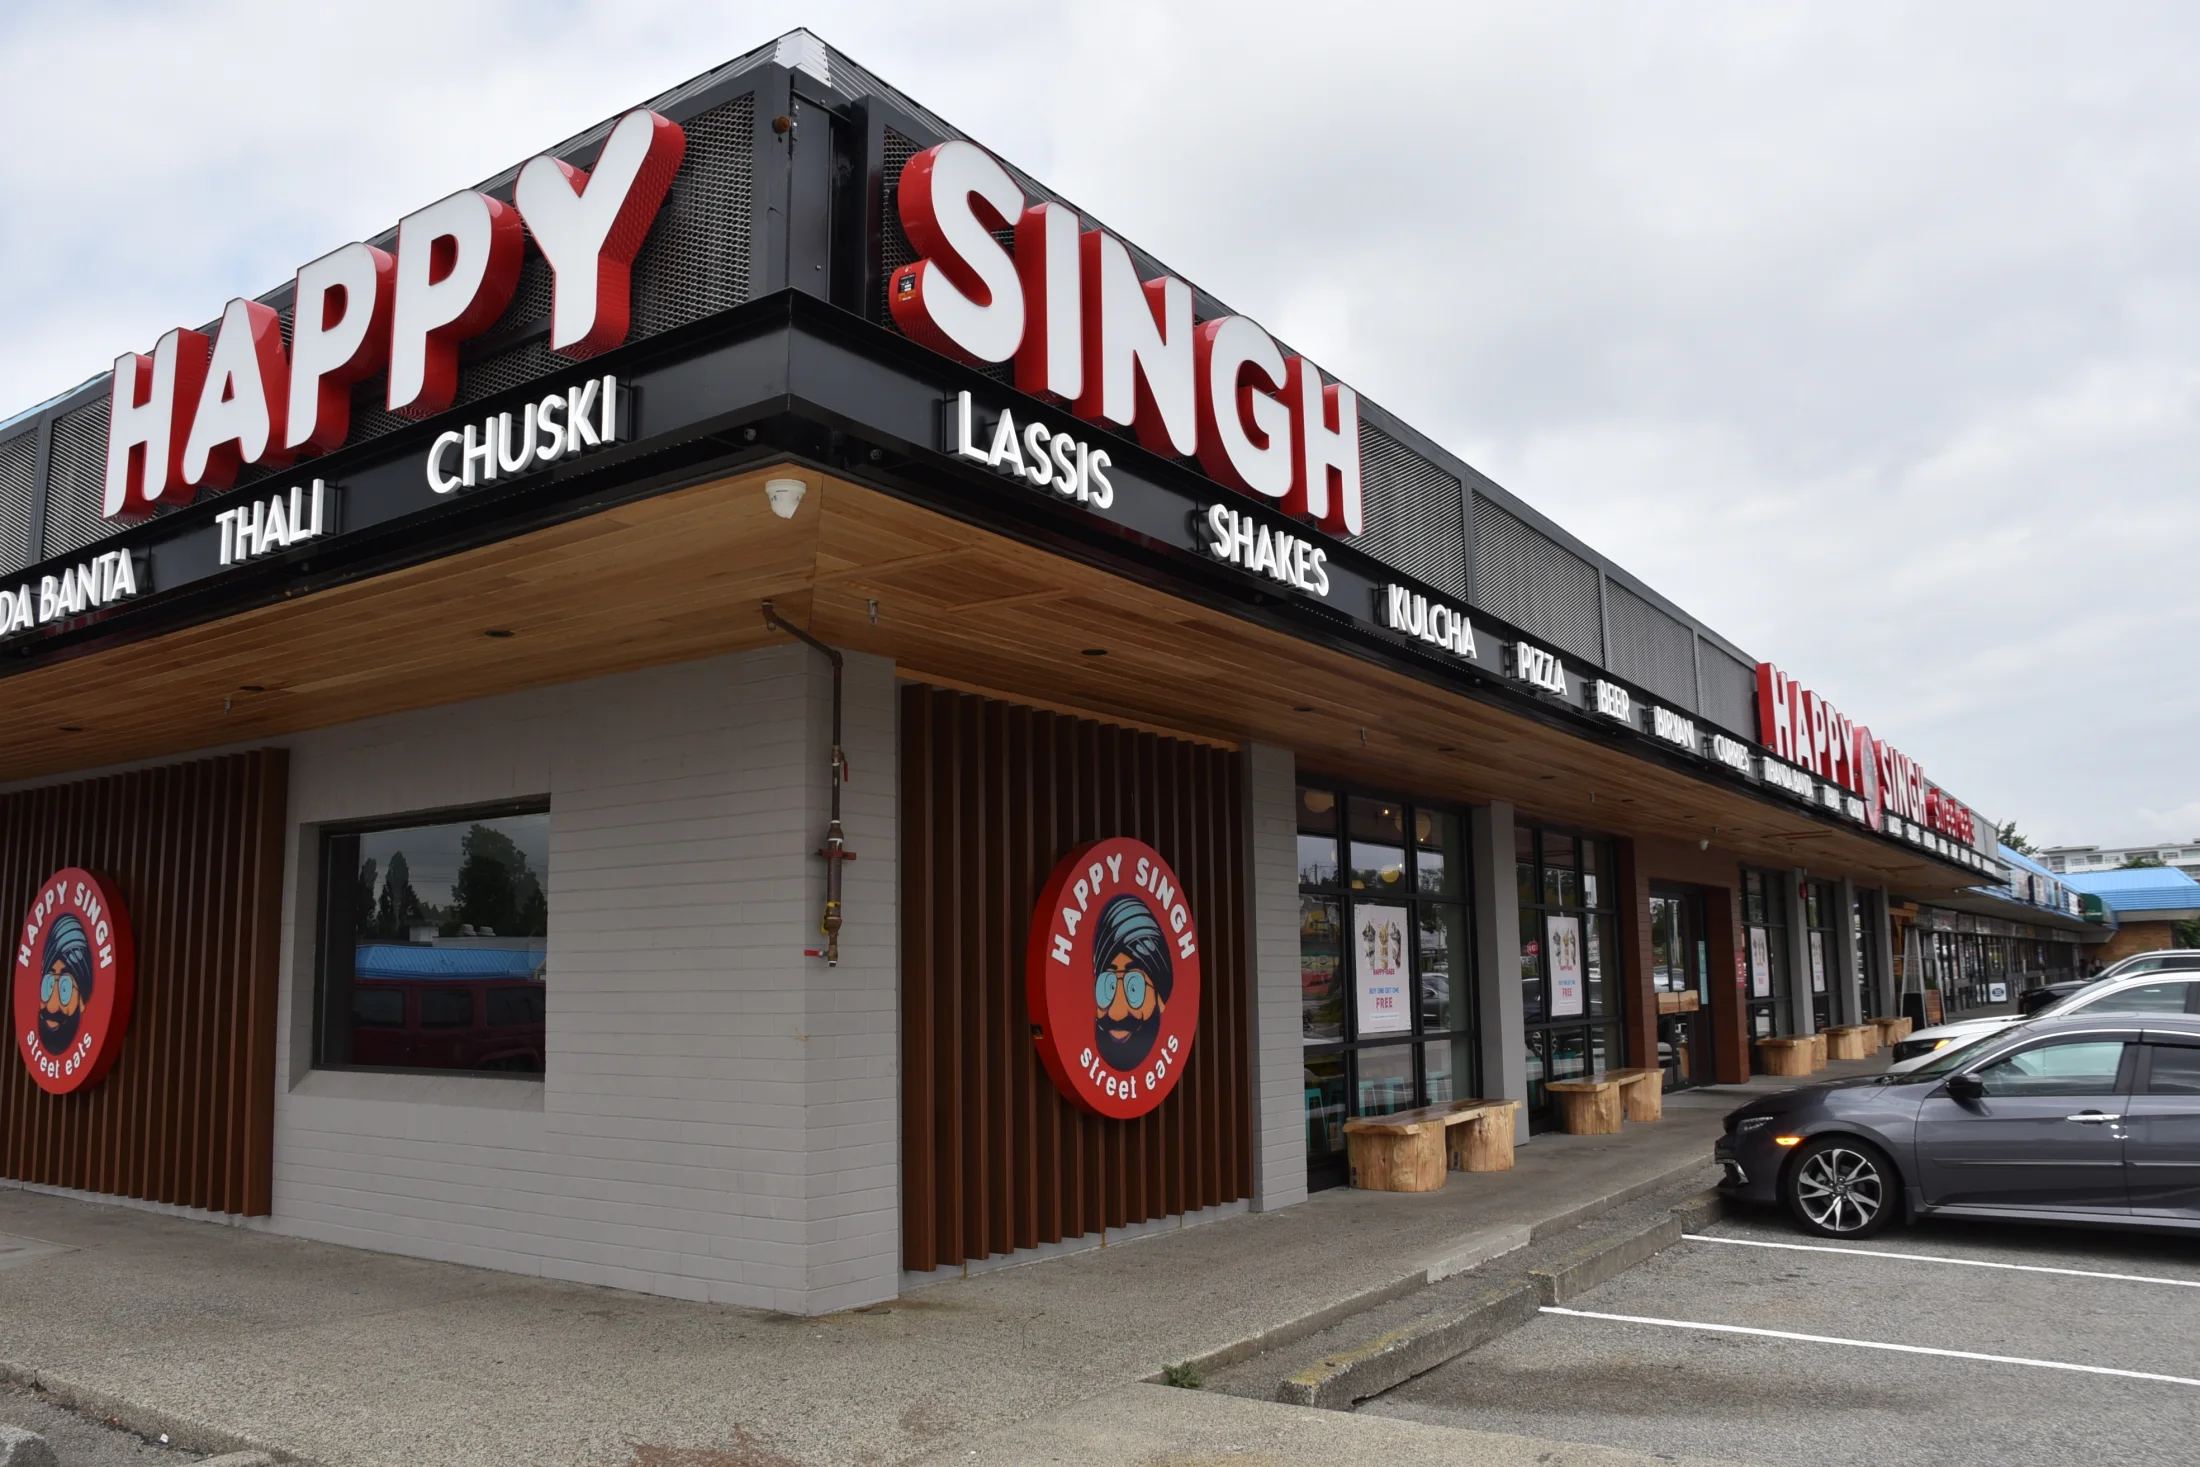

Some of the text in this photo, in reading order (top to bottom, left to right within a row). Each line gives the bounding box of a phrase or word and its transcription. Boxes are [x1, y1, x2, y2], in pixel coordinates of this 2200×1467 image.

[103, 107, 686, 523] HAPPY
[890, 139, 1364, 538] SINGH
[426, 375, 617, 495] CHUSKI
[957, 390, 1114, 509] LASSIS
[215, 478, 325, 566] THALI
[1208, 503, 1330, 597] SHAKES
[39, 547, 137, 623] BANTA
[1387, 583, 1478, 659] KULCHA
[1517, 641, 1568, 696] PIZZA
[1596, 679, 1631, 723] BEER
[1654, 705, 1696, 749] BIRYANI
[1713, 734, 1750, 772] CURRIES
[1756, 662, 1856, 792] HAPPY
[1873, 739, 1928, 827] SINGH
[18, 880, 112, 968] HAPPY SINGH
[1051, 853, 1196, 966] HAPPY SINGH
[1376, 997, 1392, 1008] FREE
[27, 1031, 92, 1079] street eats
[1080, 1034, 1179, 1100] street eats
